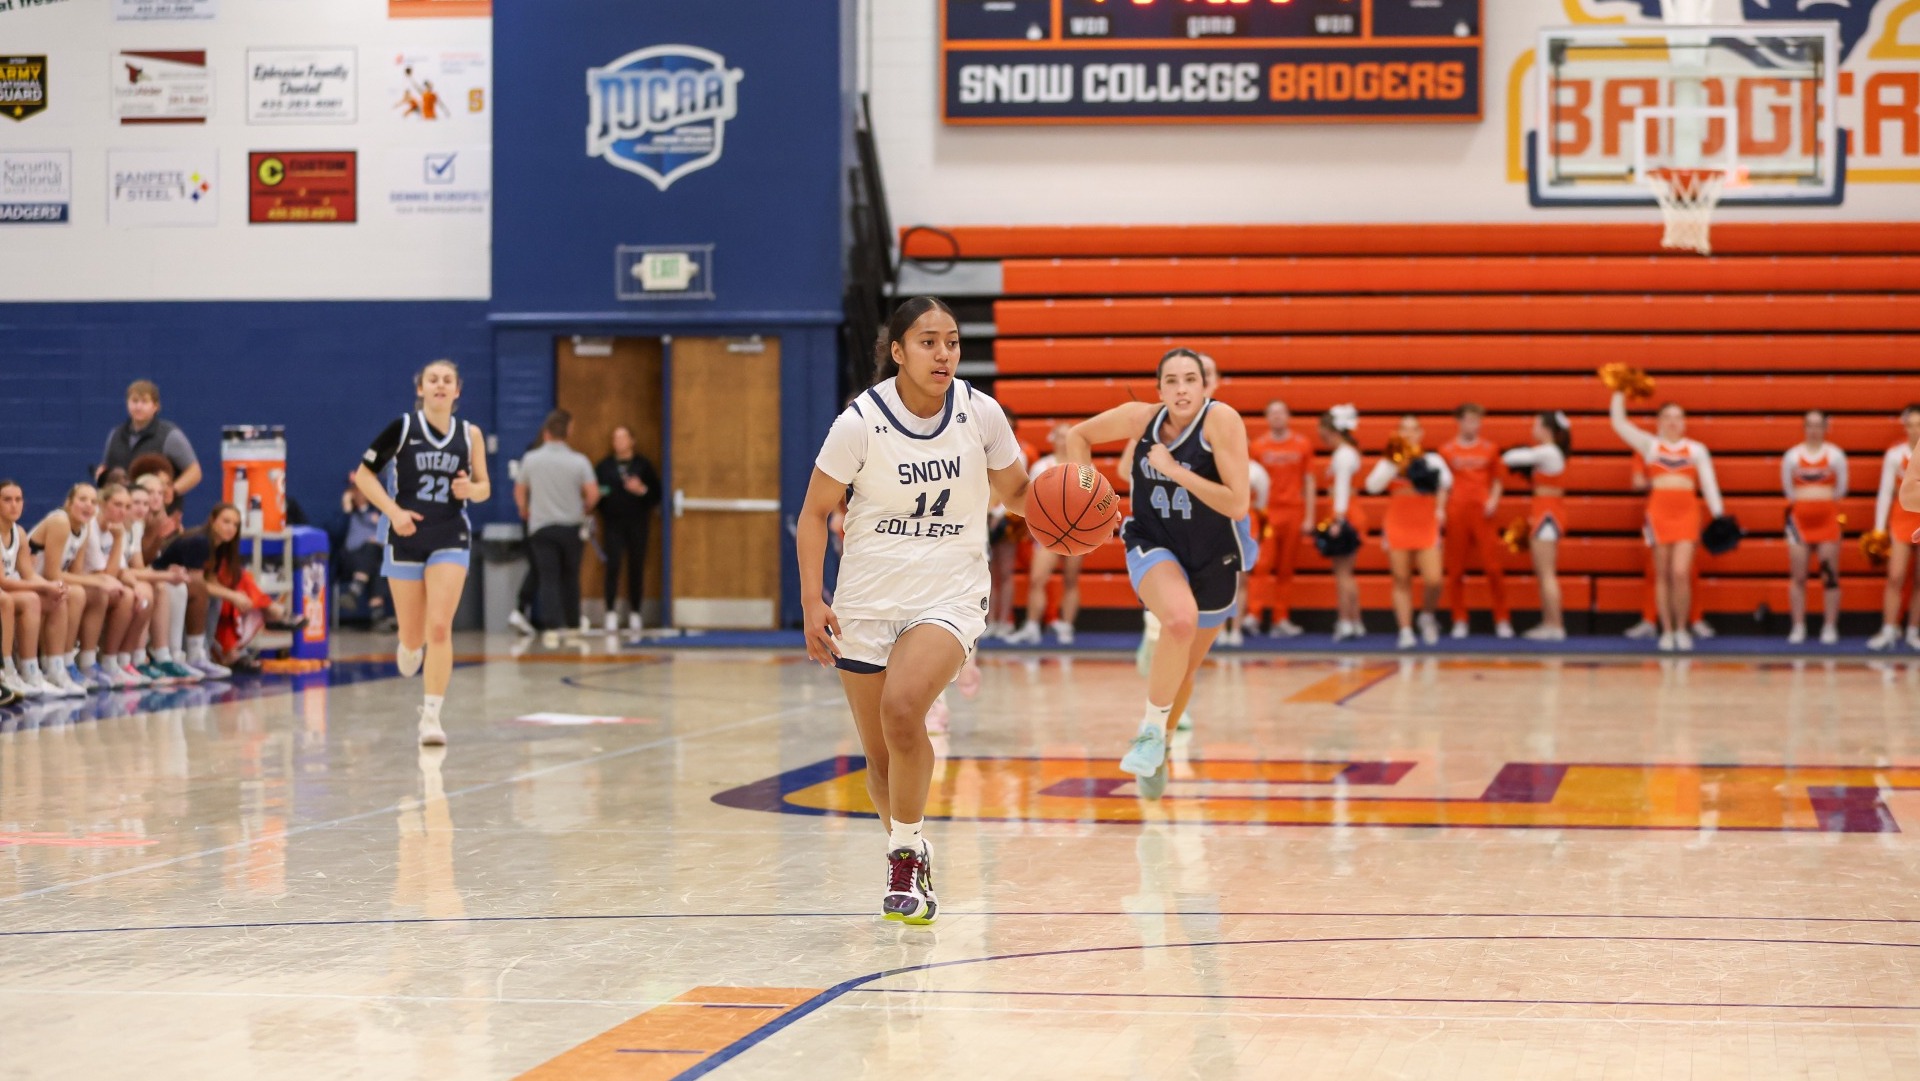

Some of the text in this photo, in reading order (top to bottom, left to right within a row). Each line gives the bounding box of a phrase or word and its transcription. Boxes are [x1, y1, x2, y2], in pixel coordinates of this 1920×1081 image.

[308, 63, 349, 82] Family
[280, 81, 322, 95] Dental
[959, 62, 1465, 103] SNOW COLLEGE BADGERS
[3, 160, 62, 173] Security
[3, 172, 62, 186] National
[115, 172, 184, 186] SANPETE
[127, 188, 171, 201] STEEL
[0, 205, 63, 220] ADGERS!
[415, 451, 460, 474] OTERO
[898, 456, 961, 485] SNOW
[416, 474, 451, 504] 22
[910, 488, 951, 518] 14
[1150, 485, 1193, 520] 44
